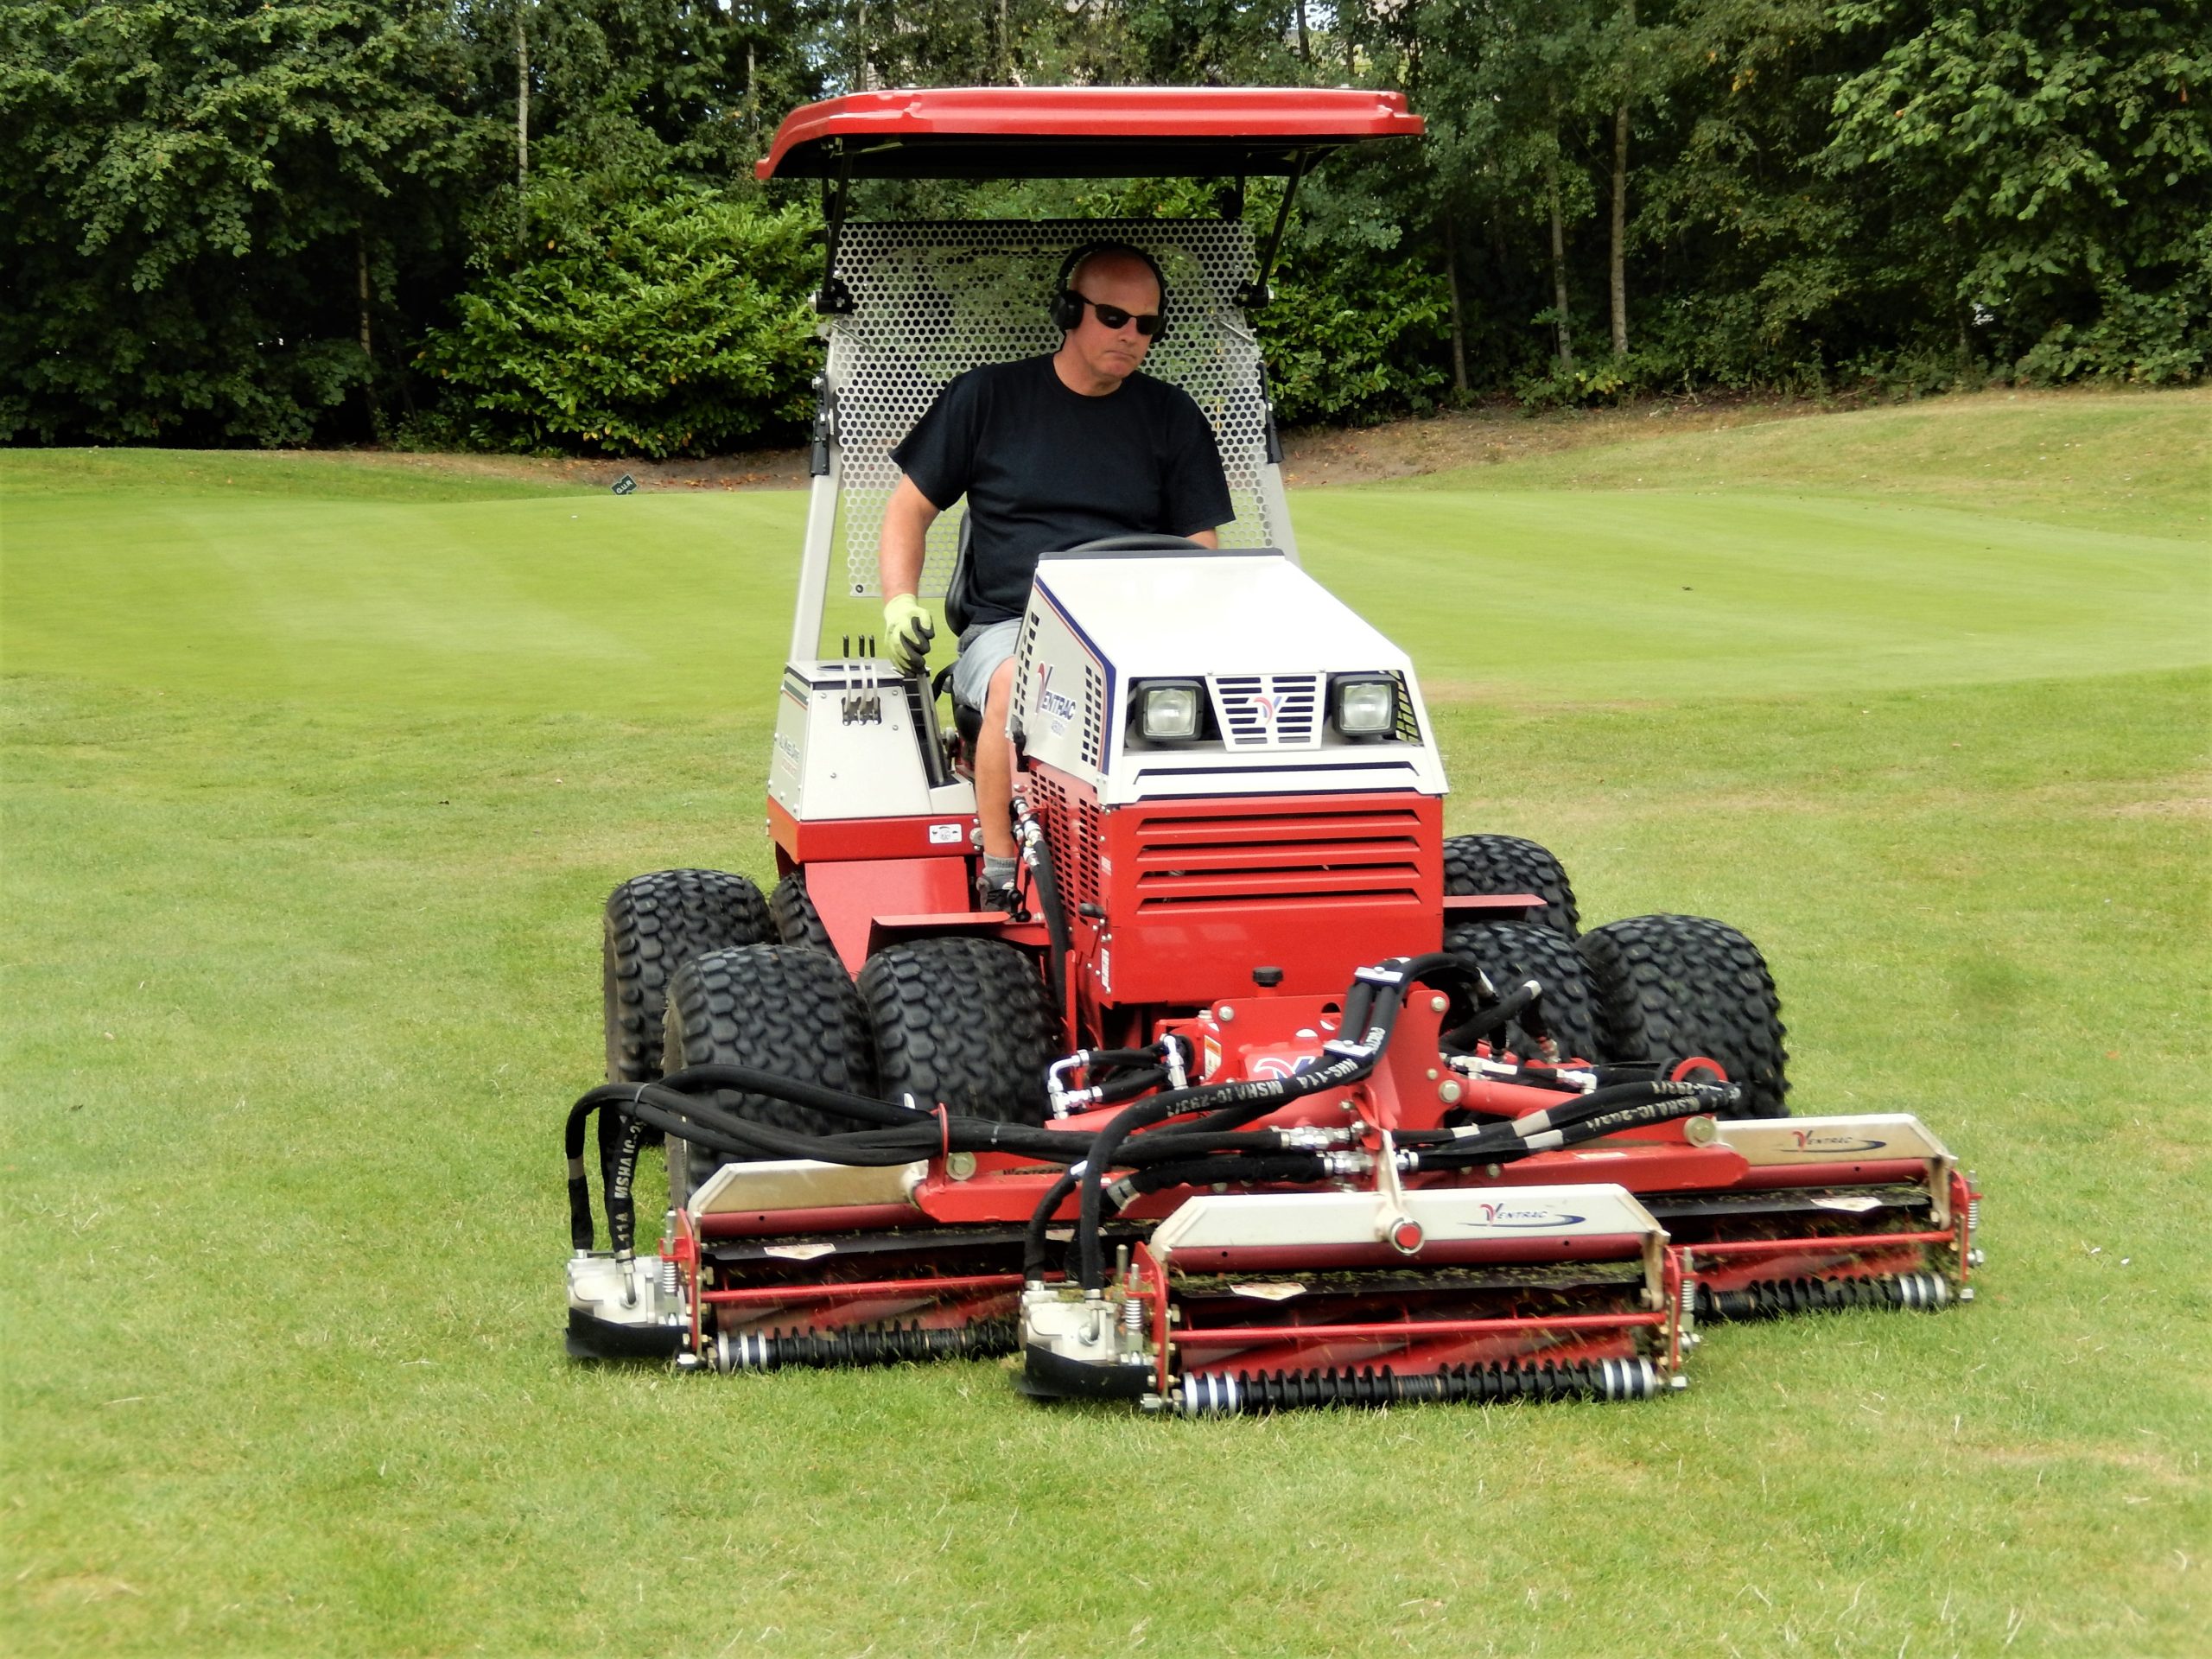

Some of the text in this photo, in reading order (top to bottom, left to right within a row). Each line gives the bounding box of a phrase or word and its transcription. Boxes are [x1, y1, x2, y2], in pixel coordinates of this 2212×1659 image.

[1036, 663, 1077, 721] VENTRAC
[1236, 1080, 1284, 1101] MSHA
[613, 1157, 632, 1199] MSHA
[1479, 1203, 1548, 1224] VENTRAC
